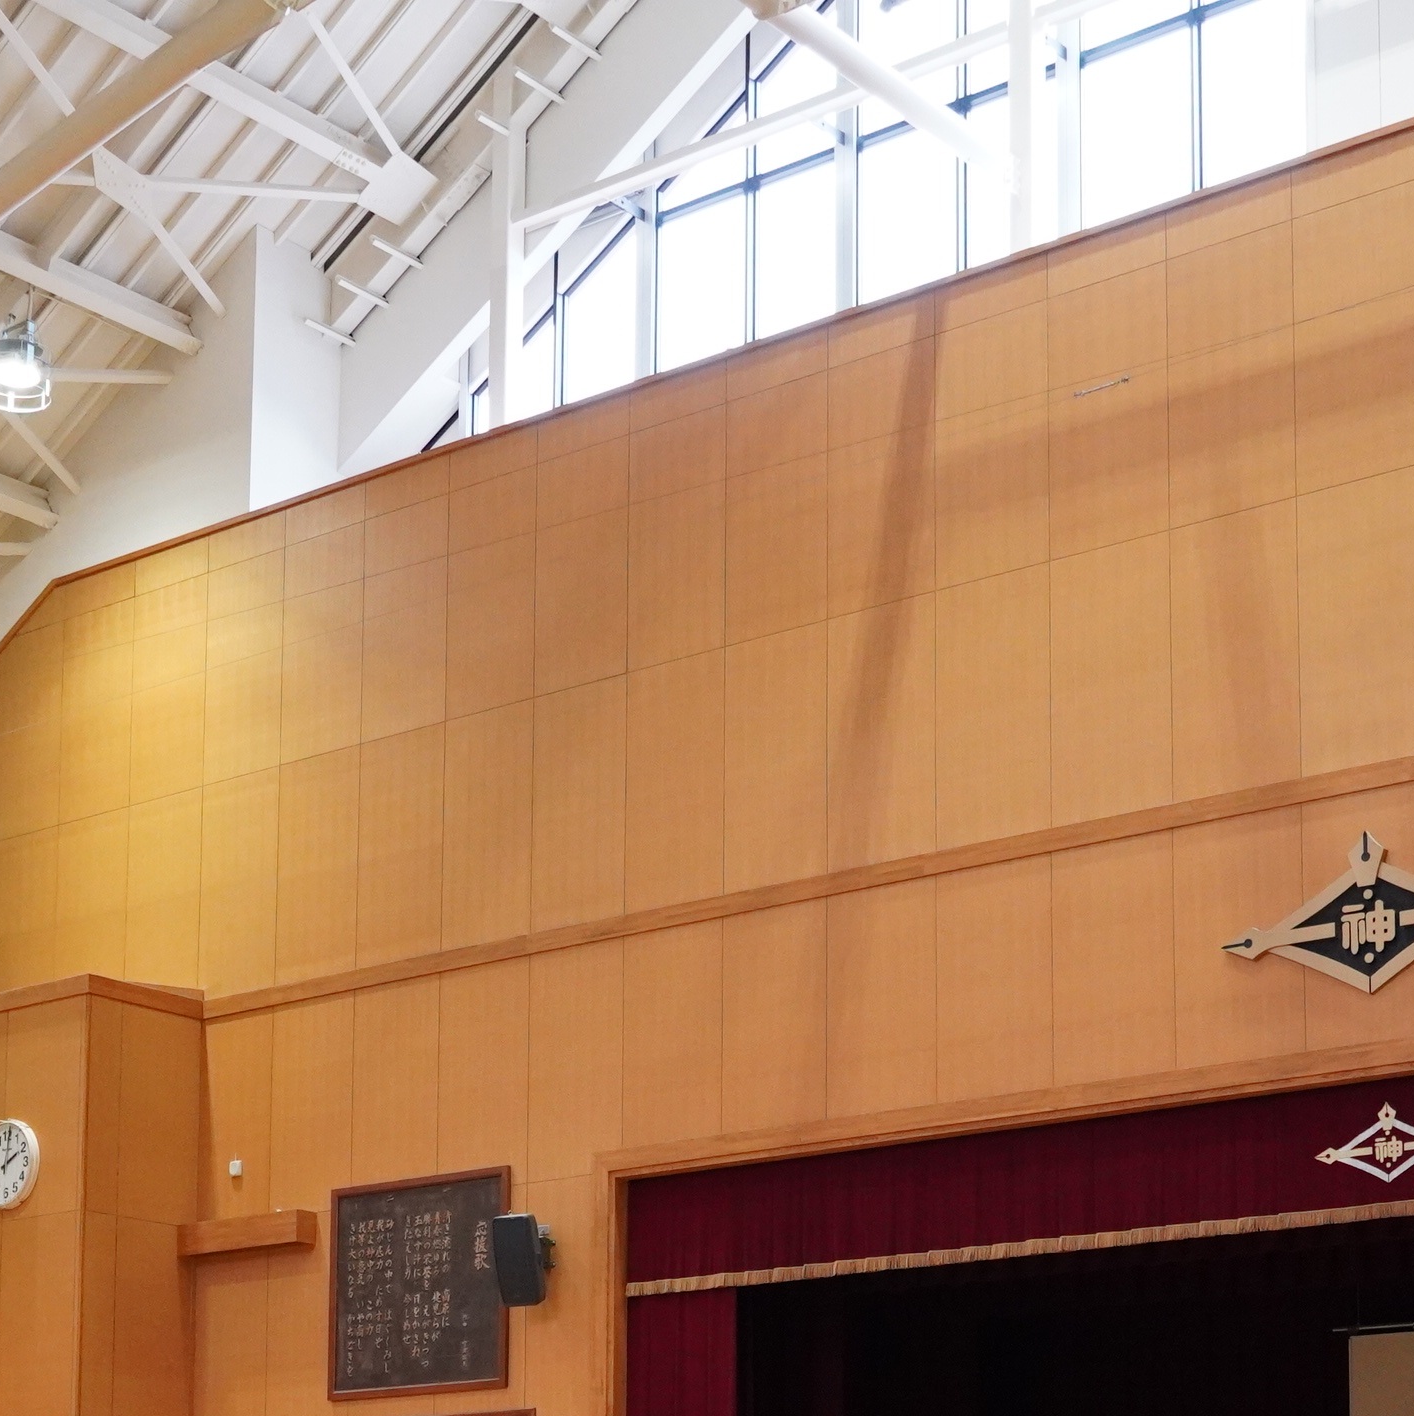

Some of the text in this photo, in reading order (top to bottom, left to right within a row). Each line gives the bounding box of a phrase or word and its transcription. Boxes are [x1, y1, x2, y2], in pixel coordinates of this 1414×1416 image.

[1341, 899, 1396, 955] 神
[1374, 1134, 1404, 1164] 神
[473, 1219, 491, 1271] 応援歌
